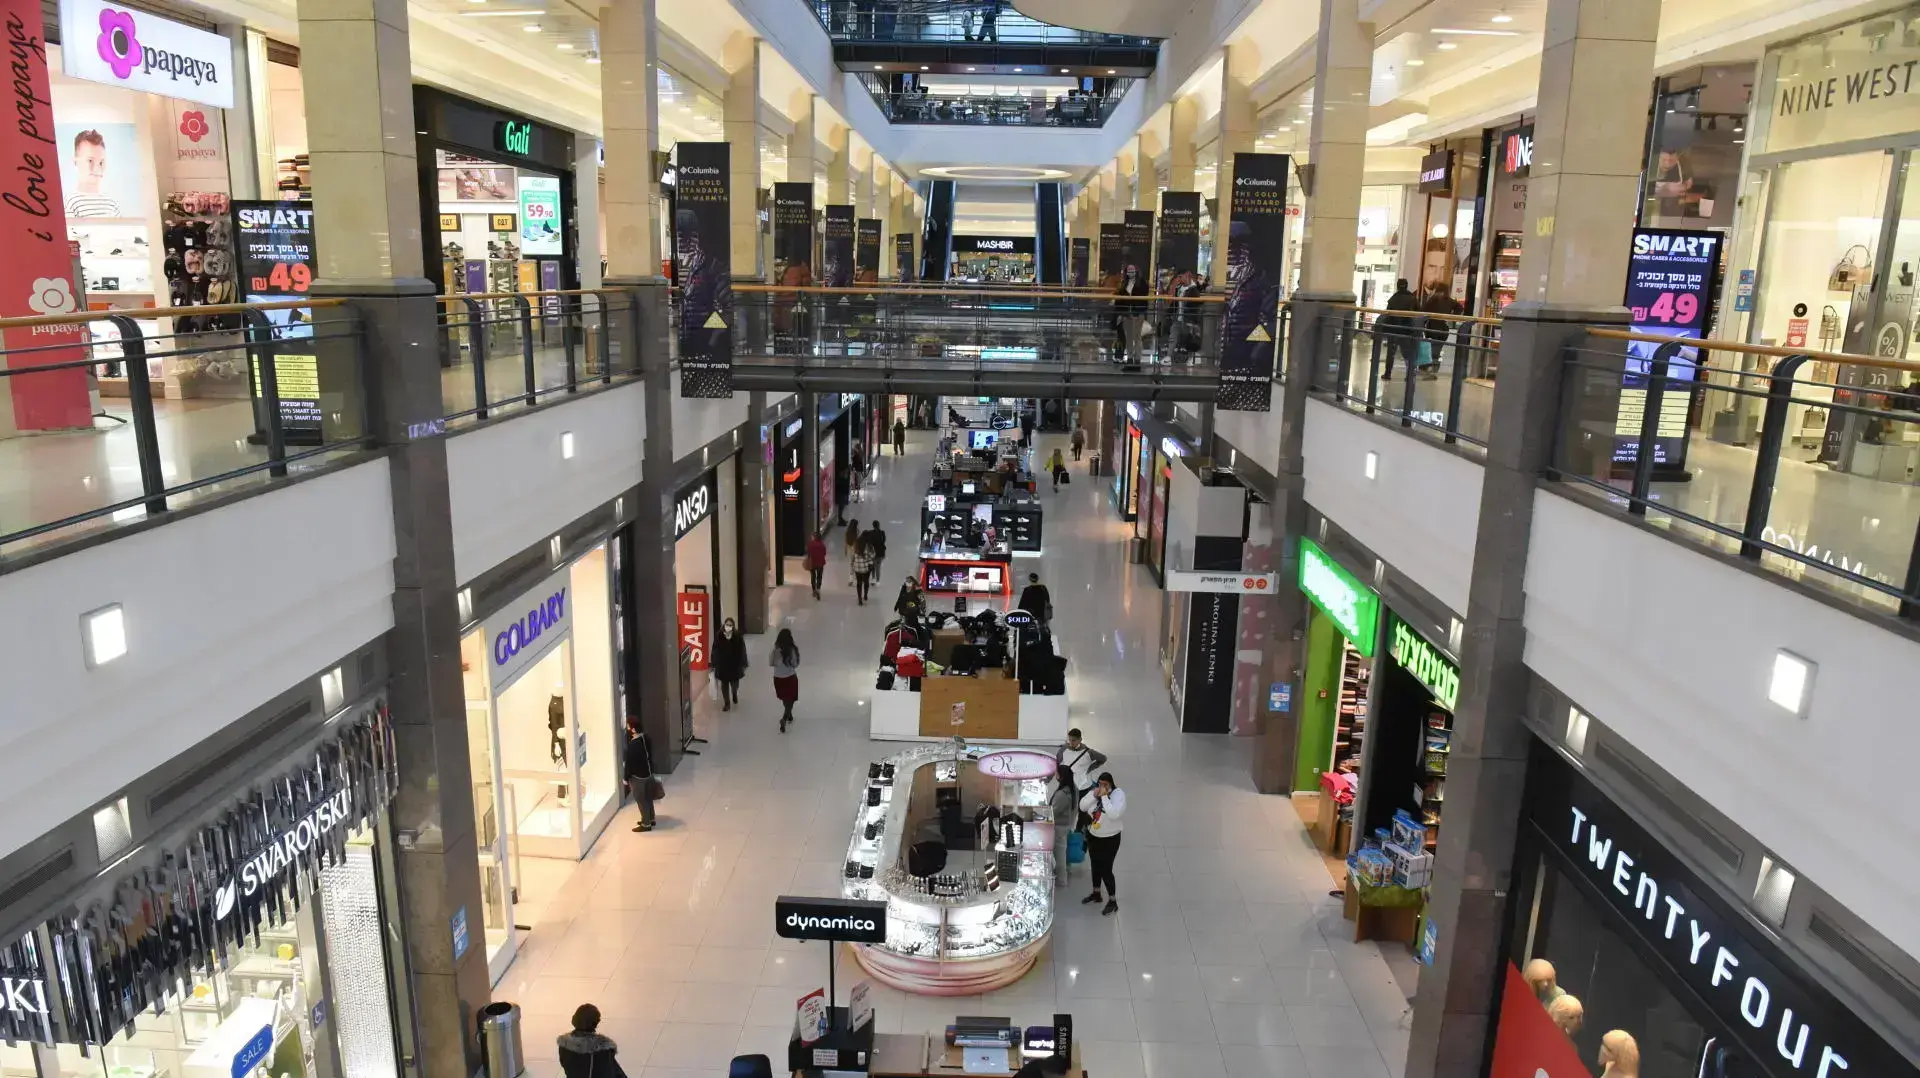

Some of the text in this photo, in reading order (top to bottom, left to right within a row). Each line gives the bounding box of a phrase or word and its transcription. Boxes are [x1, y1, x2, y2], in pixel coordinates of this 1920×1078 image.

[6, 12, 56, 145] papaya
[141, 45, 218, 86] papaya
[1780, 60, 1918, 116] NINE WEST
[505, 120, 531, 155] Gali
[2, 153, 50, 217] love
[687, 166, 720, 174] Columbia
[1243, 178, 1277, 186] Columbia
[239, 209, 313, 228] SMART
[977, 240, 1014, 249] MASHBIR
[1633, 234, 1717, 257] SMART
[269, 262, 312, 292] 49
[1637, 271, 1702, 285] מגן מסך זכוכית
[1650, 292, 1698, 324] 49
[675, 485, 708, 536] ANGO
[495, 587, 566, 666] GOLBARY
[684, 601, 703, 663] SALE
[1396, 621, 1460, 711] סטימצקי
[242, 789, 350, 897] SWAROVSKI
[786, 912, 875, 931] dynamica
[0, 977, 50, 1014] KI
[241, 1037, 264, 1068] SALE
[1058, 1026, 1067, 1056] SAMSU
